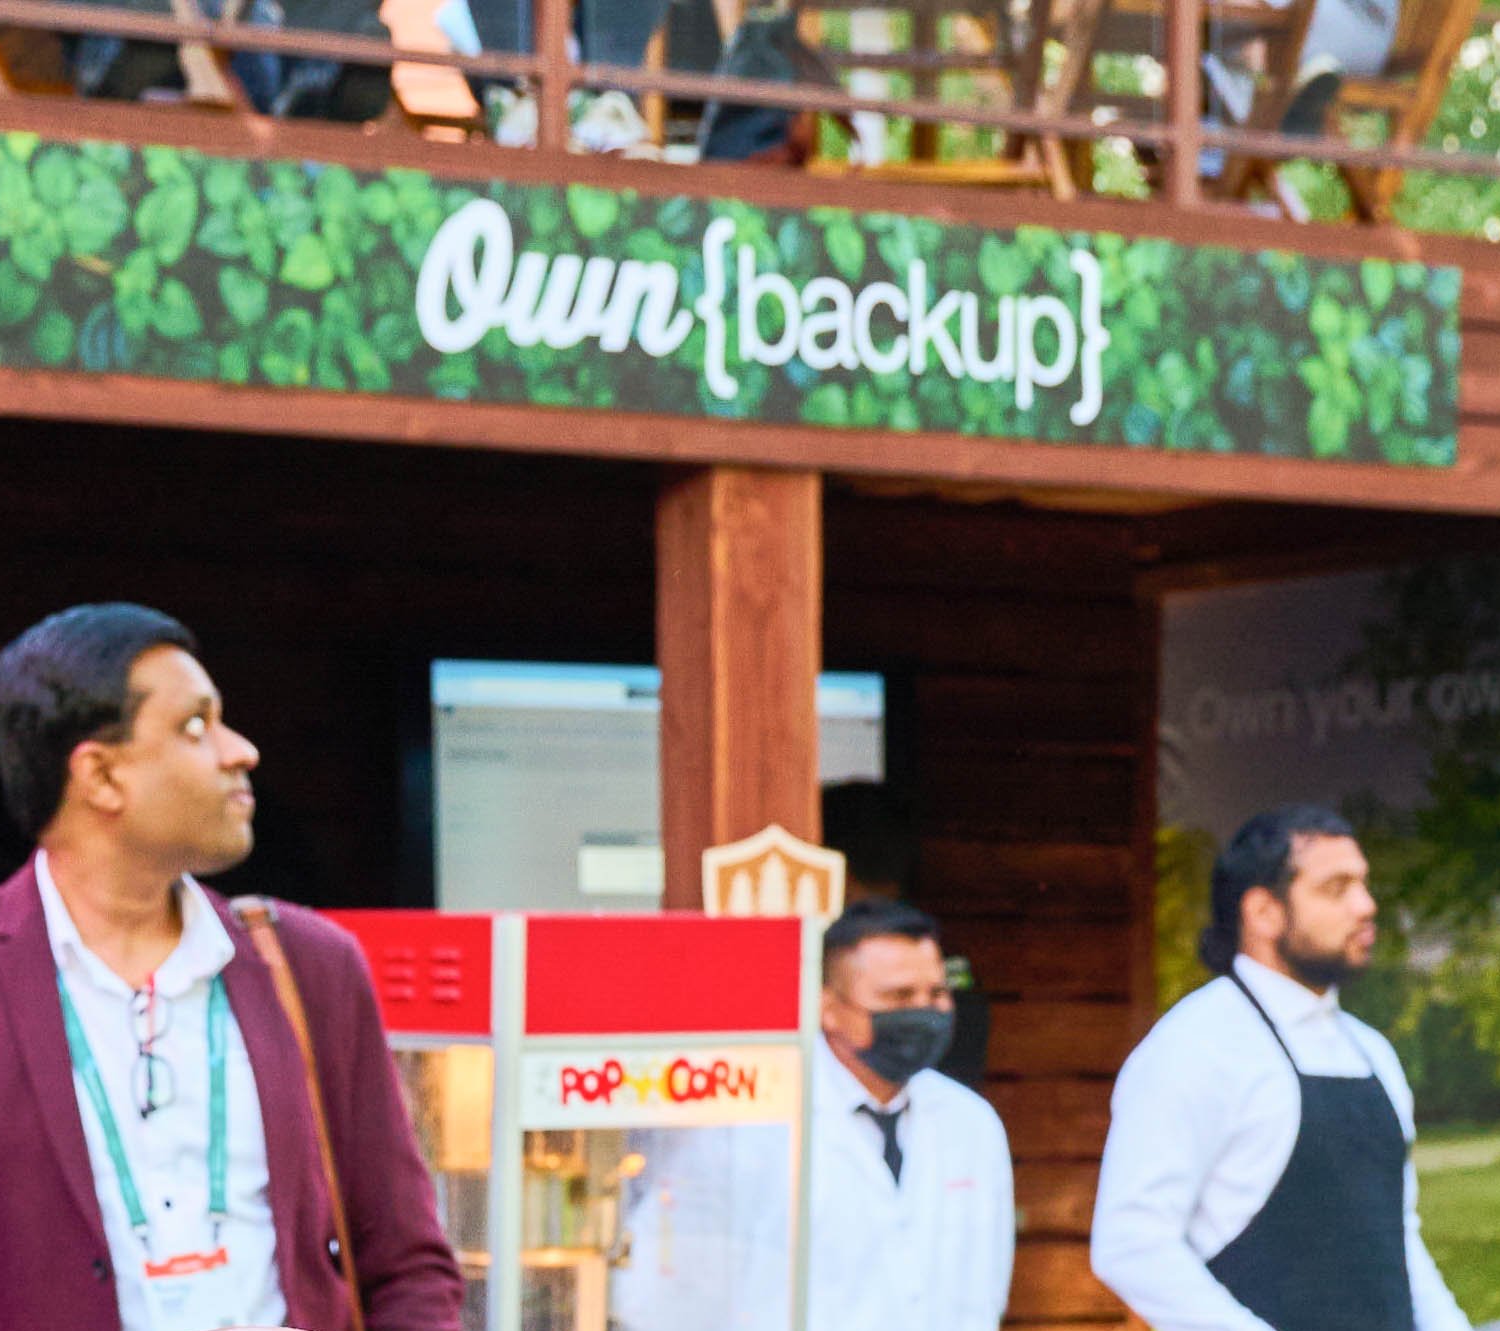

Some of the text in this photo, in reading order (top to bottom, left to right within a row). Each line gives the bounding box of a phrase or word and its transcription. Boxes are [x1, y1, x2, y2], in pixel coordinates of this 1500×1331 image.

[1187, 686, 1299, 740] Own
[1309, 682, 1416, 745] your
[560, 1056, 758, 1106] POP CORN
